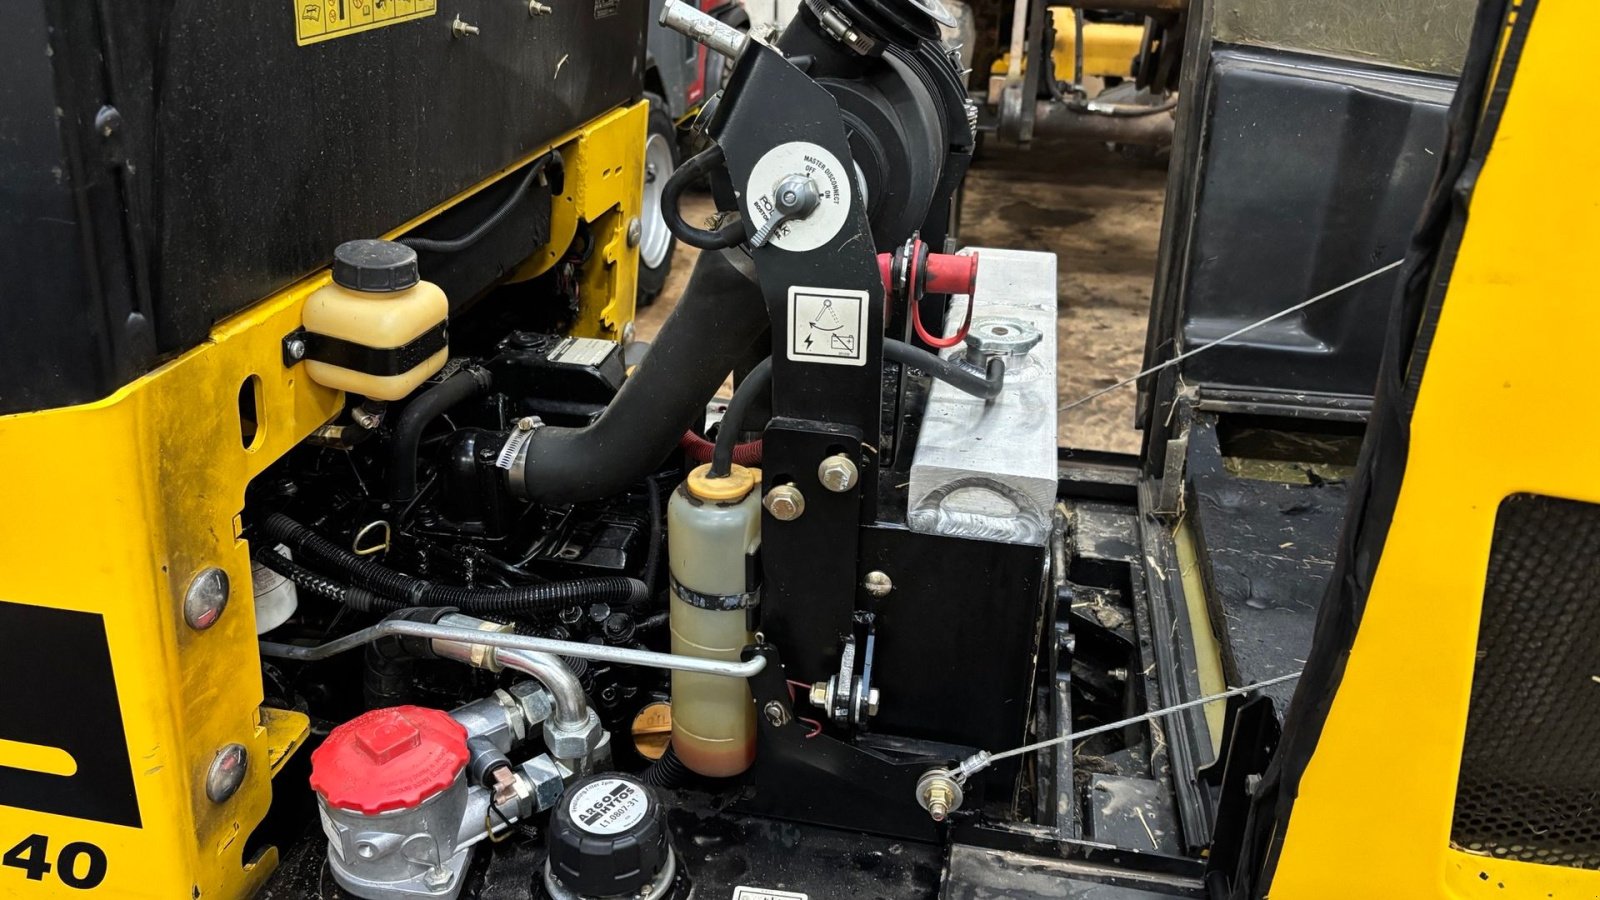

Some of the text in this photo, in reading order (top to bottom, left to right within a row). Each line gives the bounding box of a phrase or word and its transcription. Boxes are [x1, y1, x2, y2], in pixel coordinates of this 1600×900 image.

[804, 155, 840, 204] MASTER DISCONNECT
[805, 165, 816, 174] OFF
[824, 190, 831, 199] ON
[578, 795, 613, 822] ARGO
[599, 797, 639, 828] L1.0807-31
[600, 787, 635, 815] HYTOS
[2, 833, 108, 890] 40
